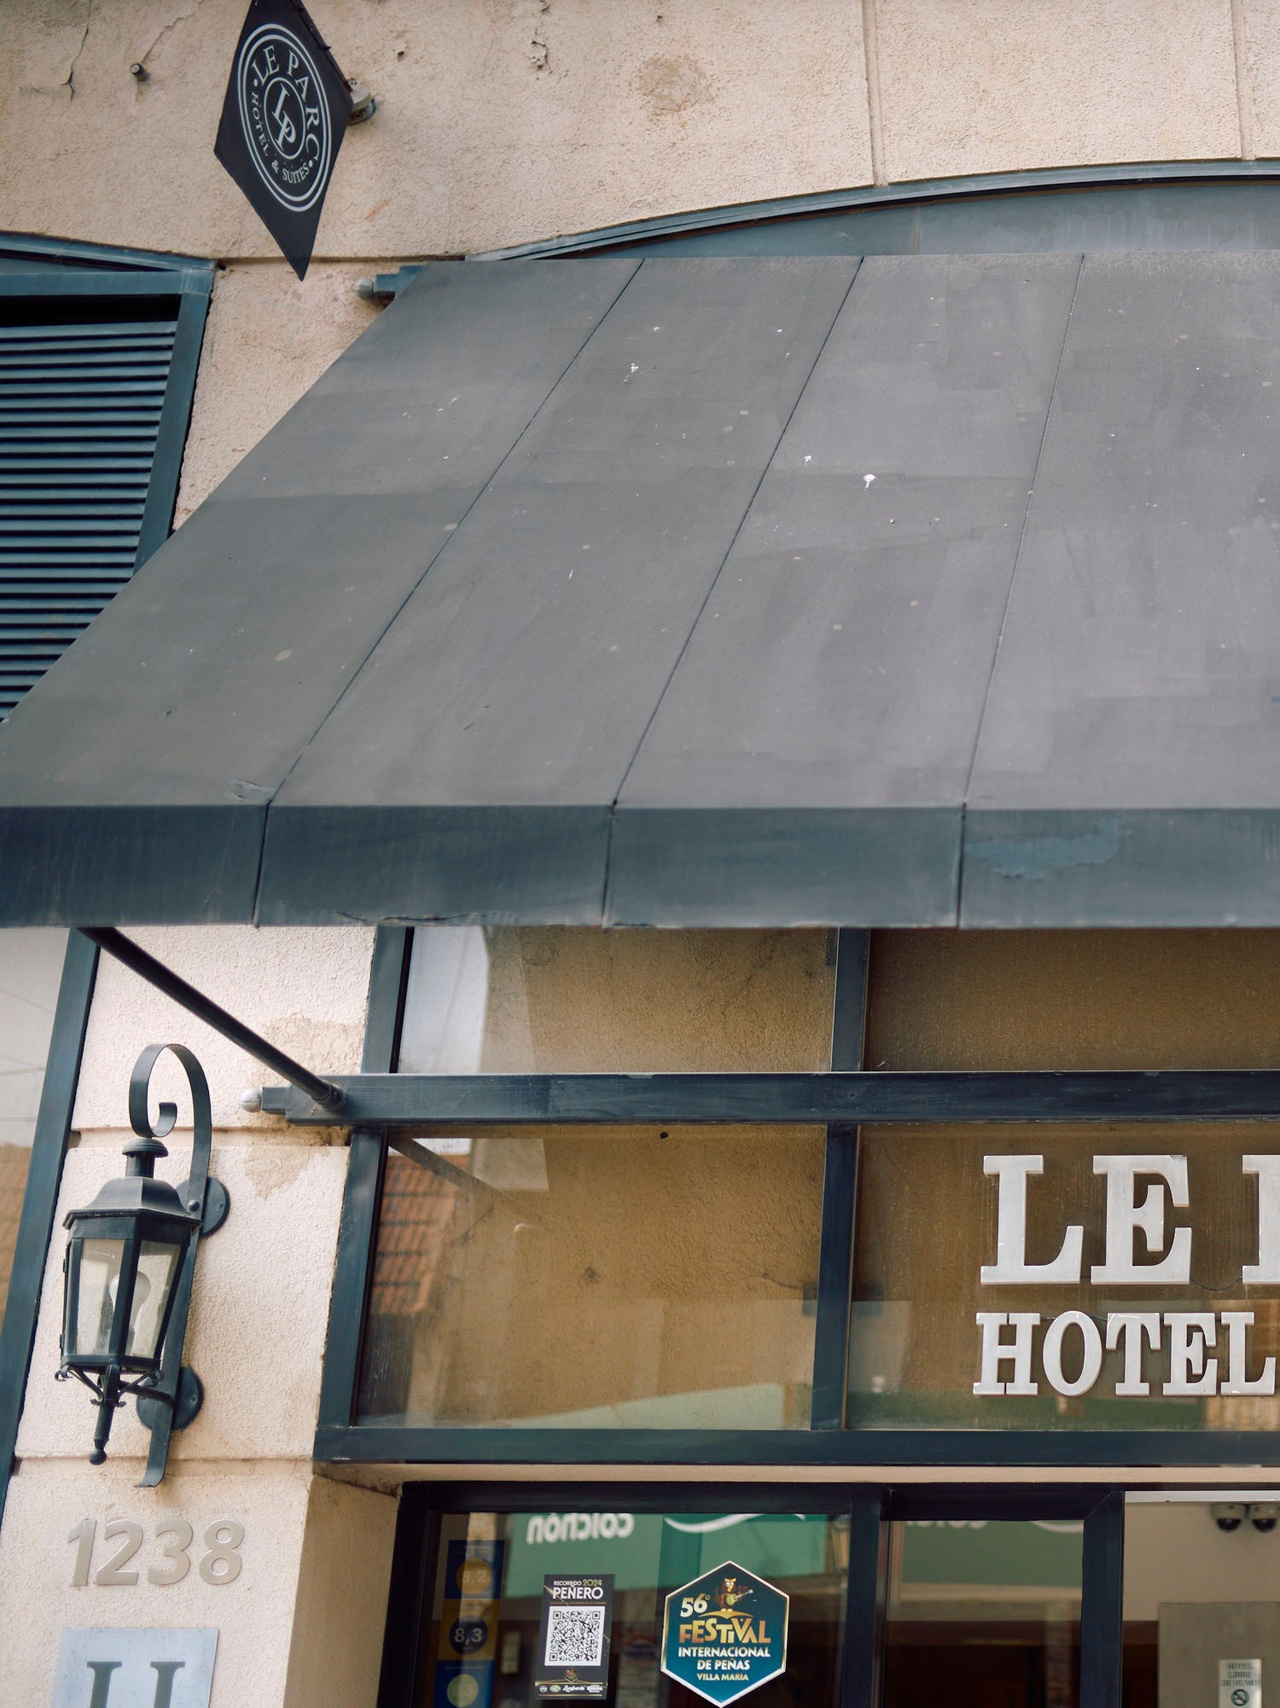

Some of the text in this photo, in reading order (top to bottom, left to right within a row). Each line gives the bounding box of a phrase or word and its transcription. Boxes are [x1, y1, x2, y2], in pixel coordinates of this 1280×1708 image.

[251, 45, 320, 161] LE PARC
[251, 90, 310, 184] HOTEL & SUITES
[980, 1153, 1193, 1287] LE
[972, 1311, 1277, 1397] HOTEL
[67, 1518, 245, 1587] 1238
[454, 1627, 483, 1645] 8,3
[678, 1646, 771, 1657] INTERNACIONAL
[697, 1658, 750, 1670] DE PEÑAS
